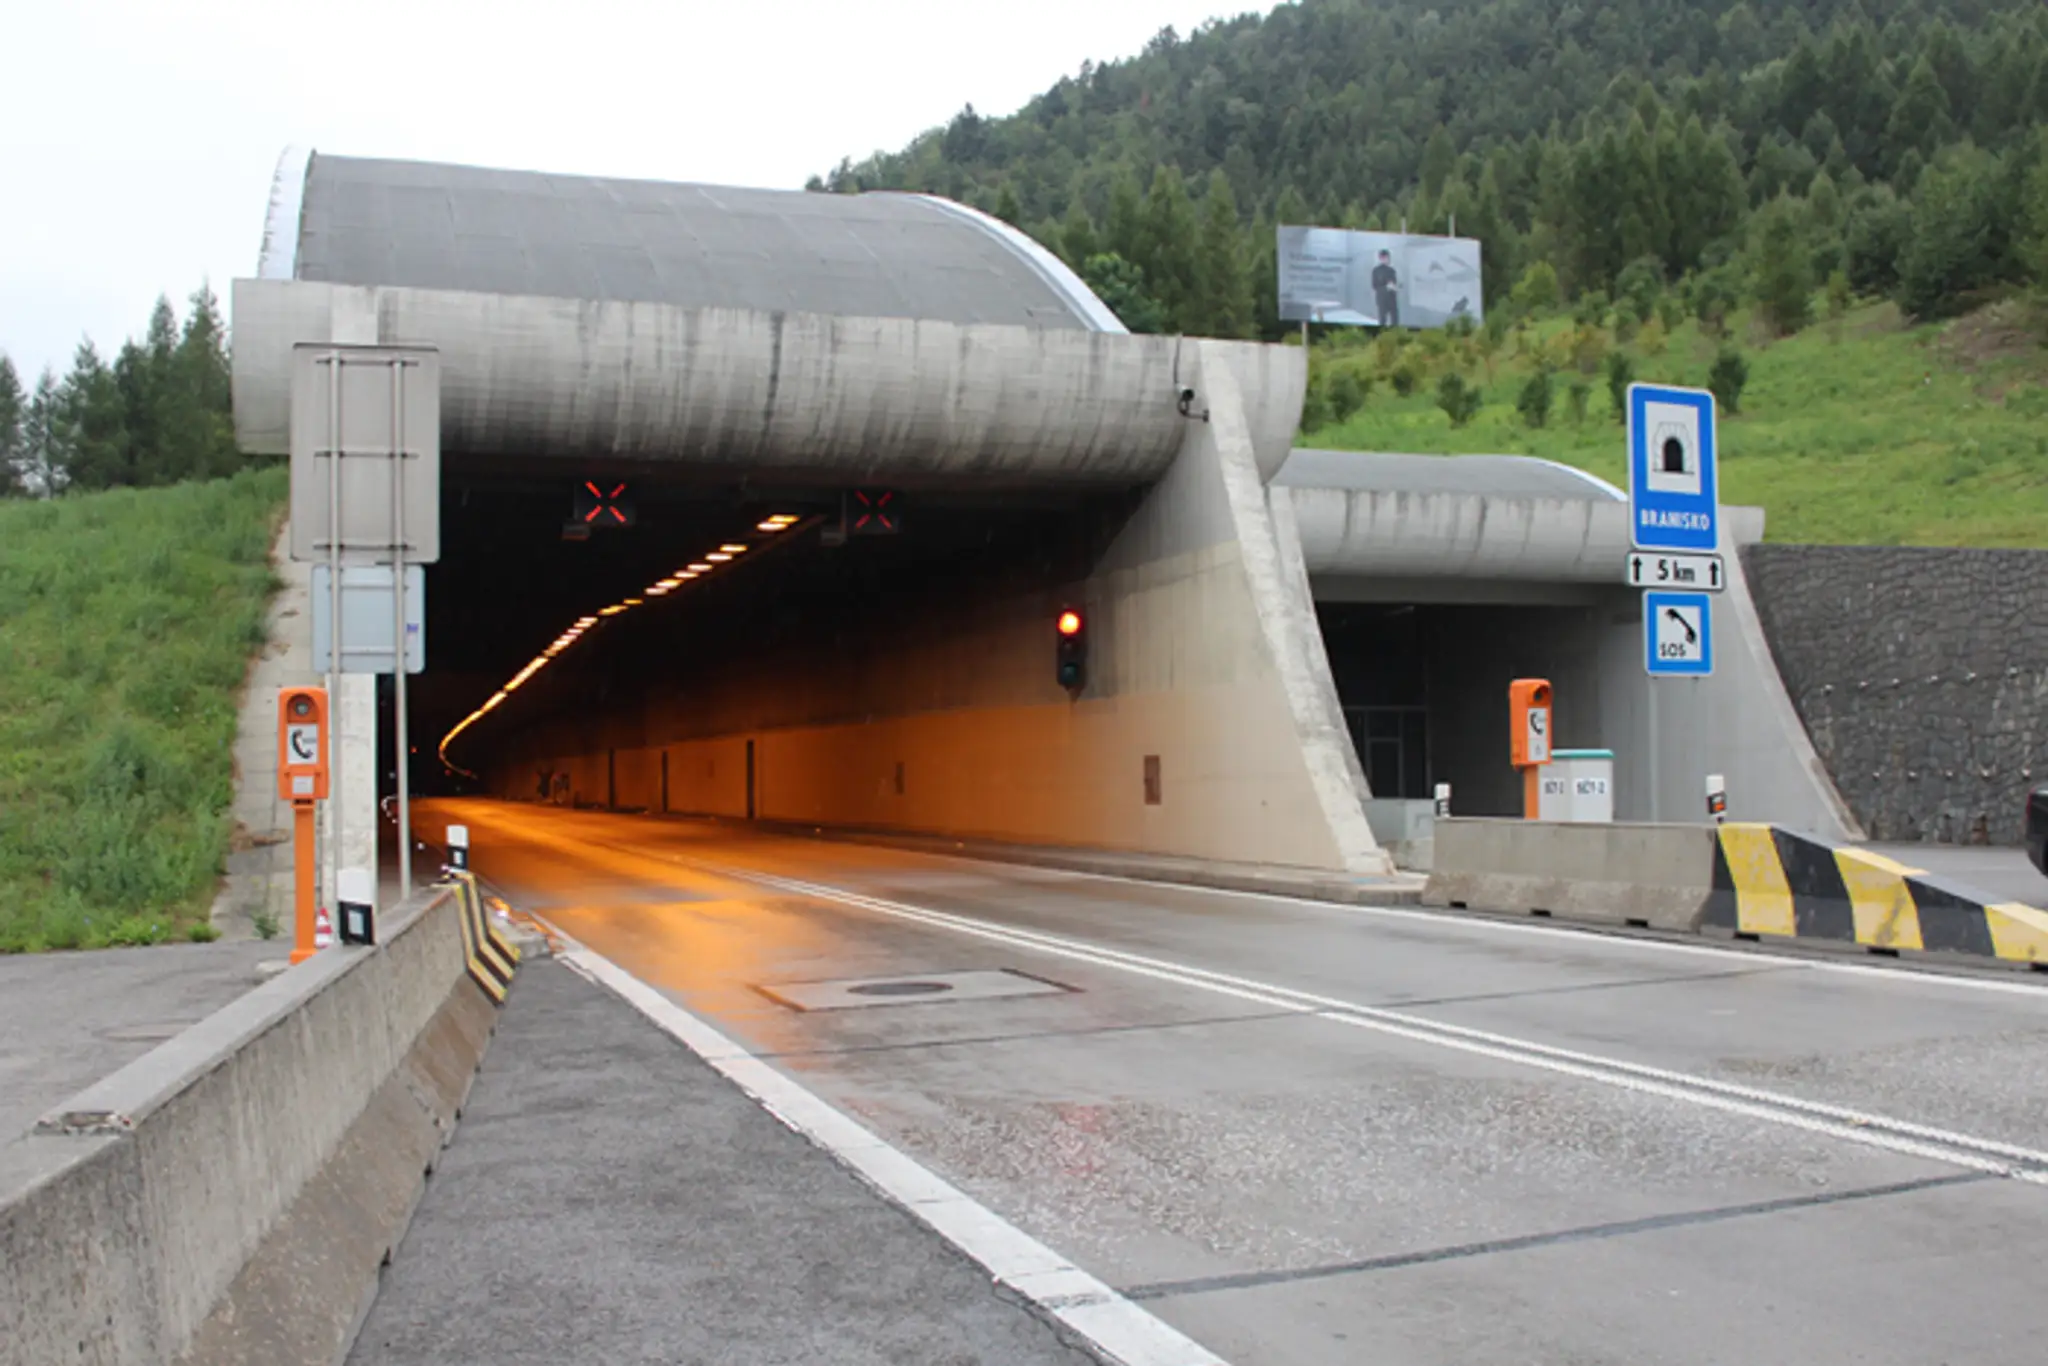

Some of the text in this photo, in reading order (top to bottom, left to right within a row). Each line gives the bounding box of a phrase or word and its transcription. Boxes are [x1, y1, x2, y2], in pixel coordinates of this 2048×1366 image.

[1640, 508, 1710, 531] BRANISKO
[1656, 558, 1695, 582] 5 km
[1659, 642, 1687, 657] SOS
